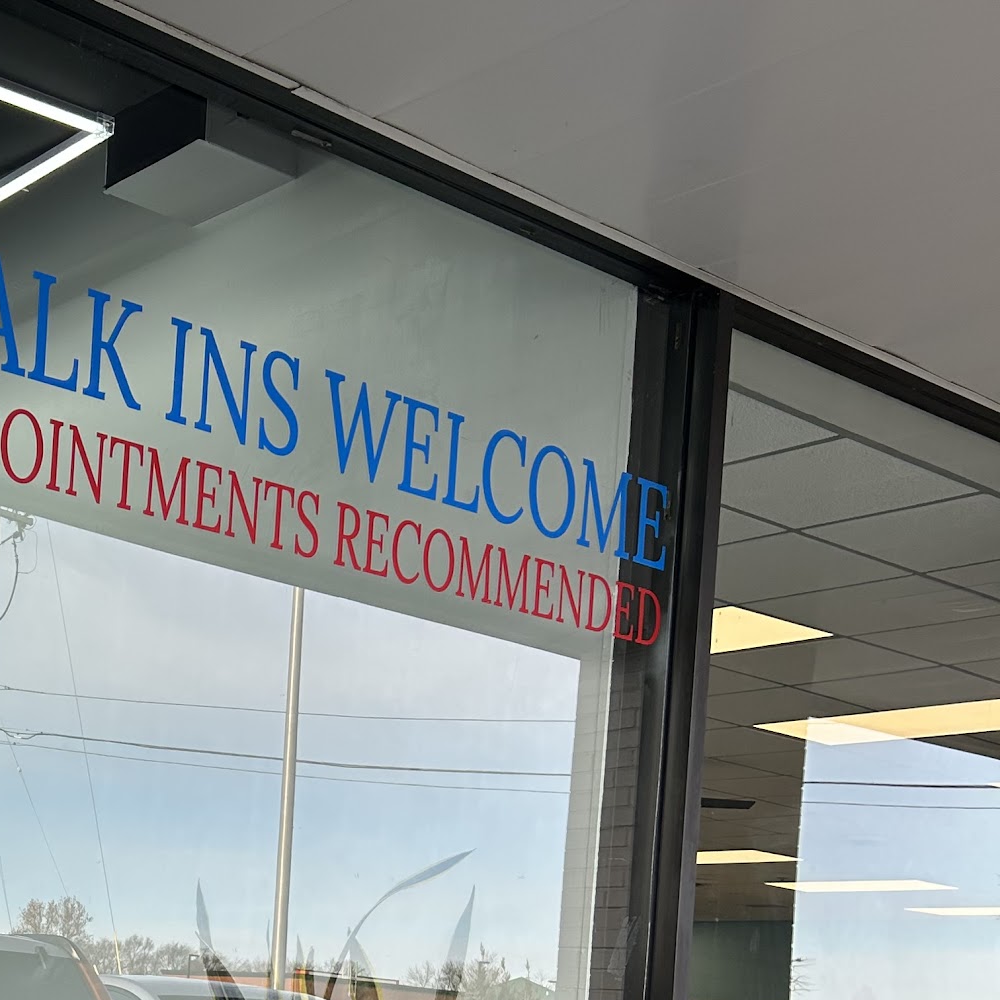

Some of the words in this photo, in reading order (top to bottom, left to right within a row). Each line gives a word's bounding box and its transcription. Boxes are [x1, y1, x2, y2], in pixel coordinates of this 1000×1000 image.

[165, 317, 300, 456] INS
[325, 368, 669, 571] WELCOME
[333, 501, 662, 646] RECOMMENDED
